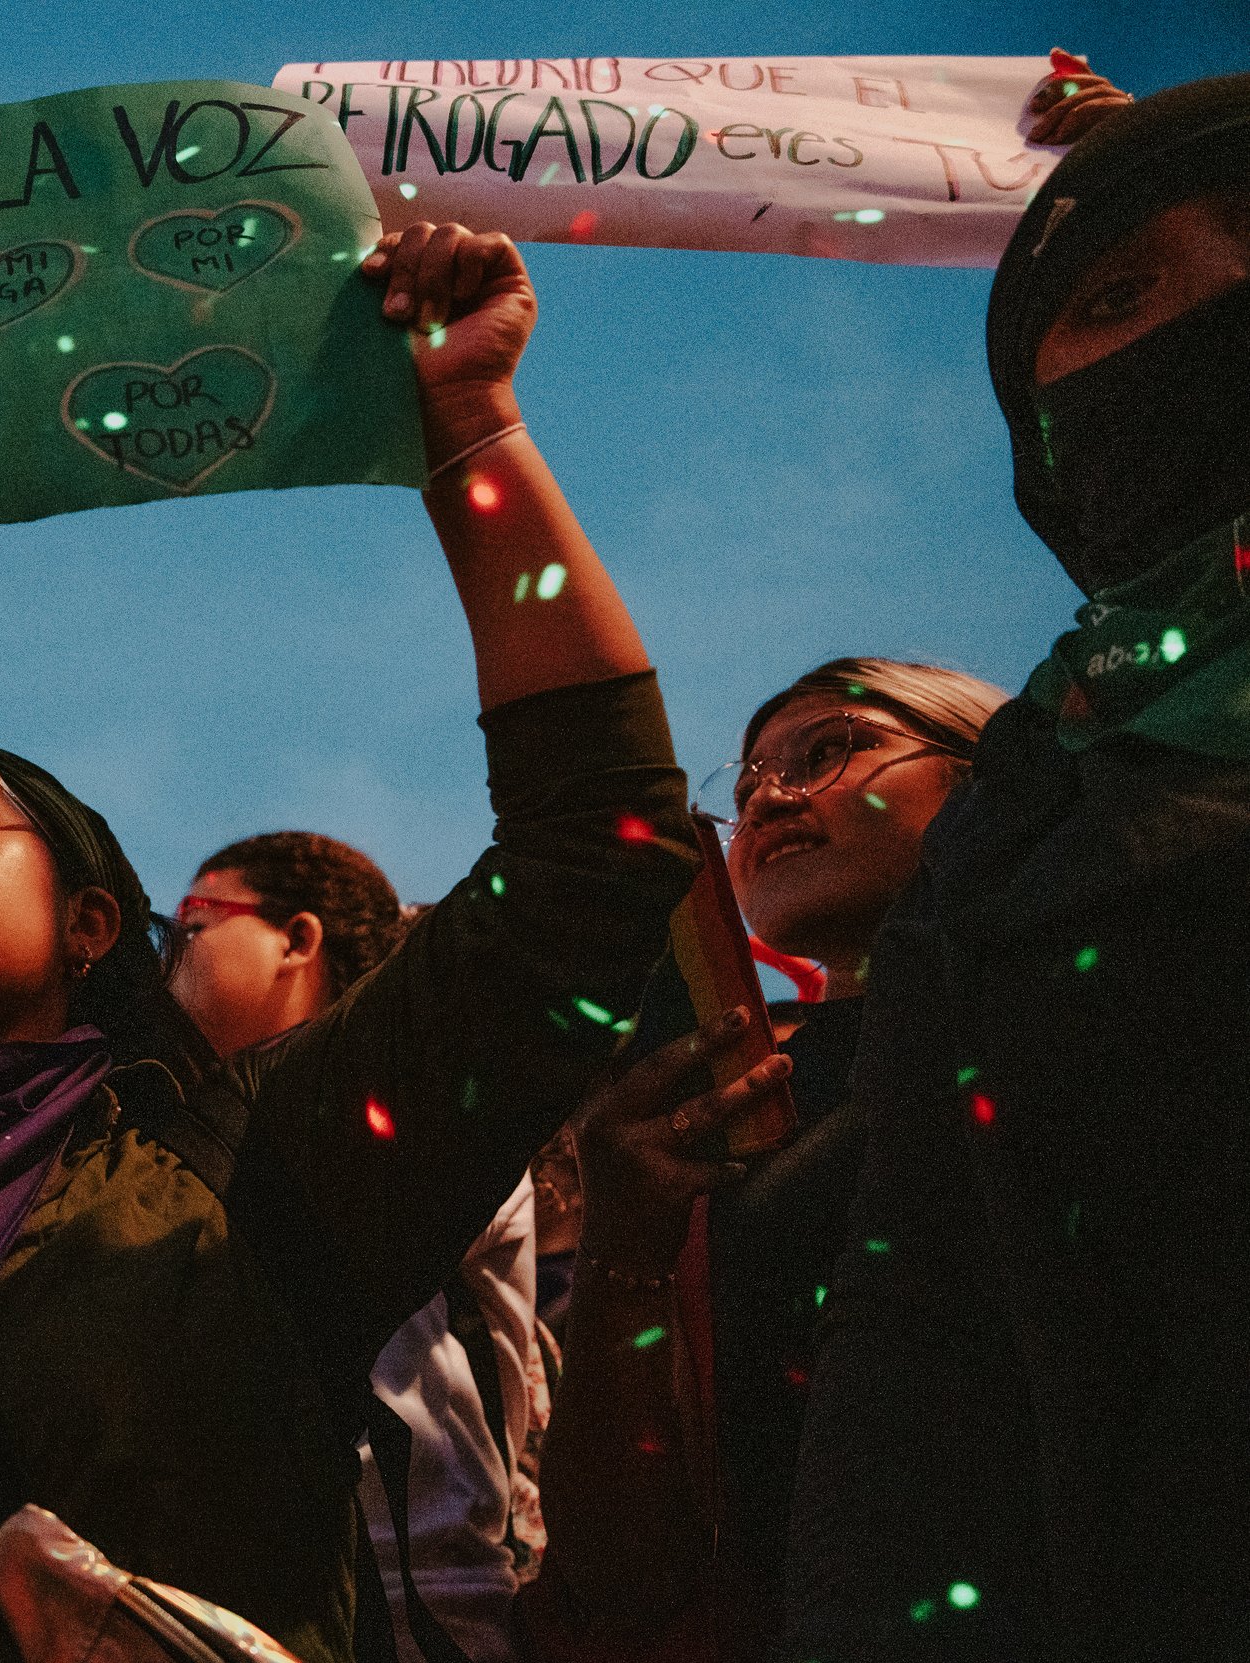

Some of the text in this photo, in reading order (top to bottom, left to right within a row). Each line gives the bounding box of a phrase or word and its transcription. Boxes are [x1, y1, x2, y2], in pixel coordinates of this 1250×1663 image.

[644, 61, 806, 96] QUE
[853, 77, 926, 113] EL
[113, 100, 330, 188] VOZ
[711, 123, 864, 168] eres
[173, 221, 256, 250] POR
[5, 250, 48, 275] MI
[191, 253, 234, 274] MI
[123, 374, 225, 415] POR
[101, 415, 255, 469] TODAS
